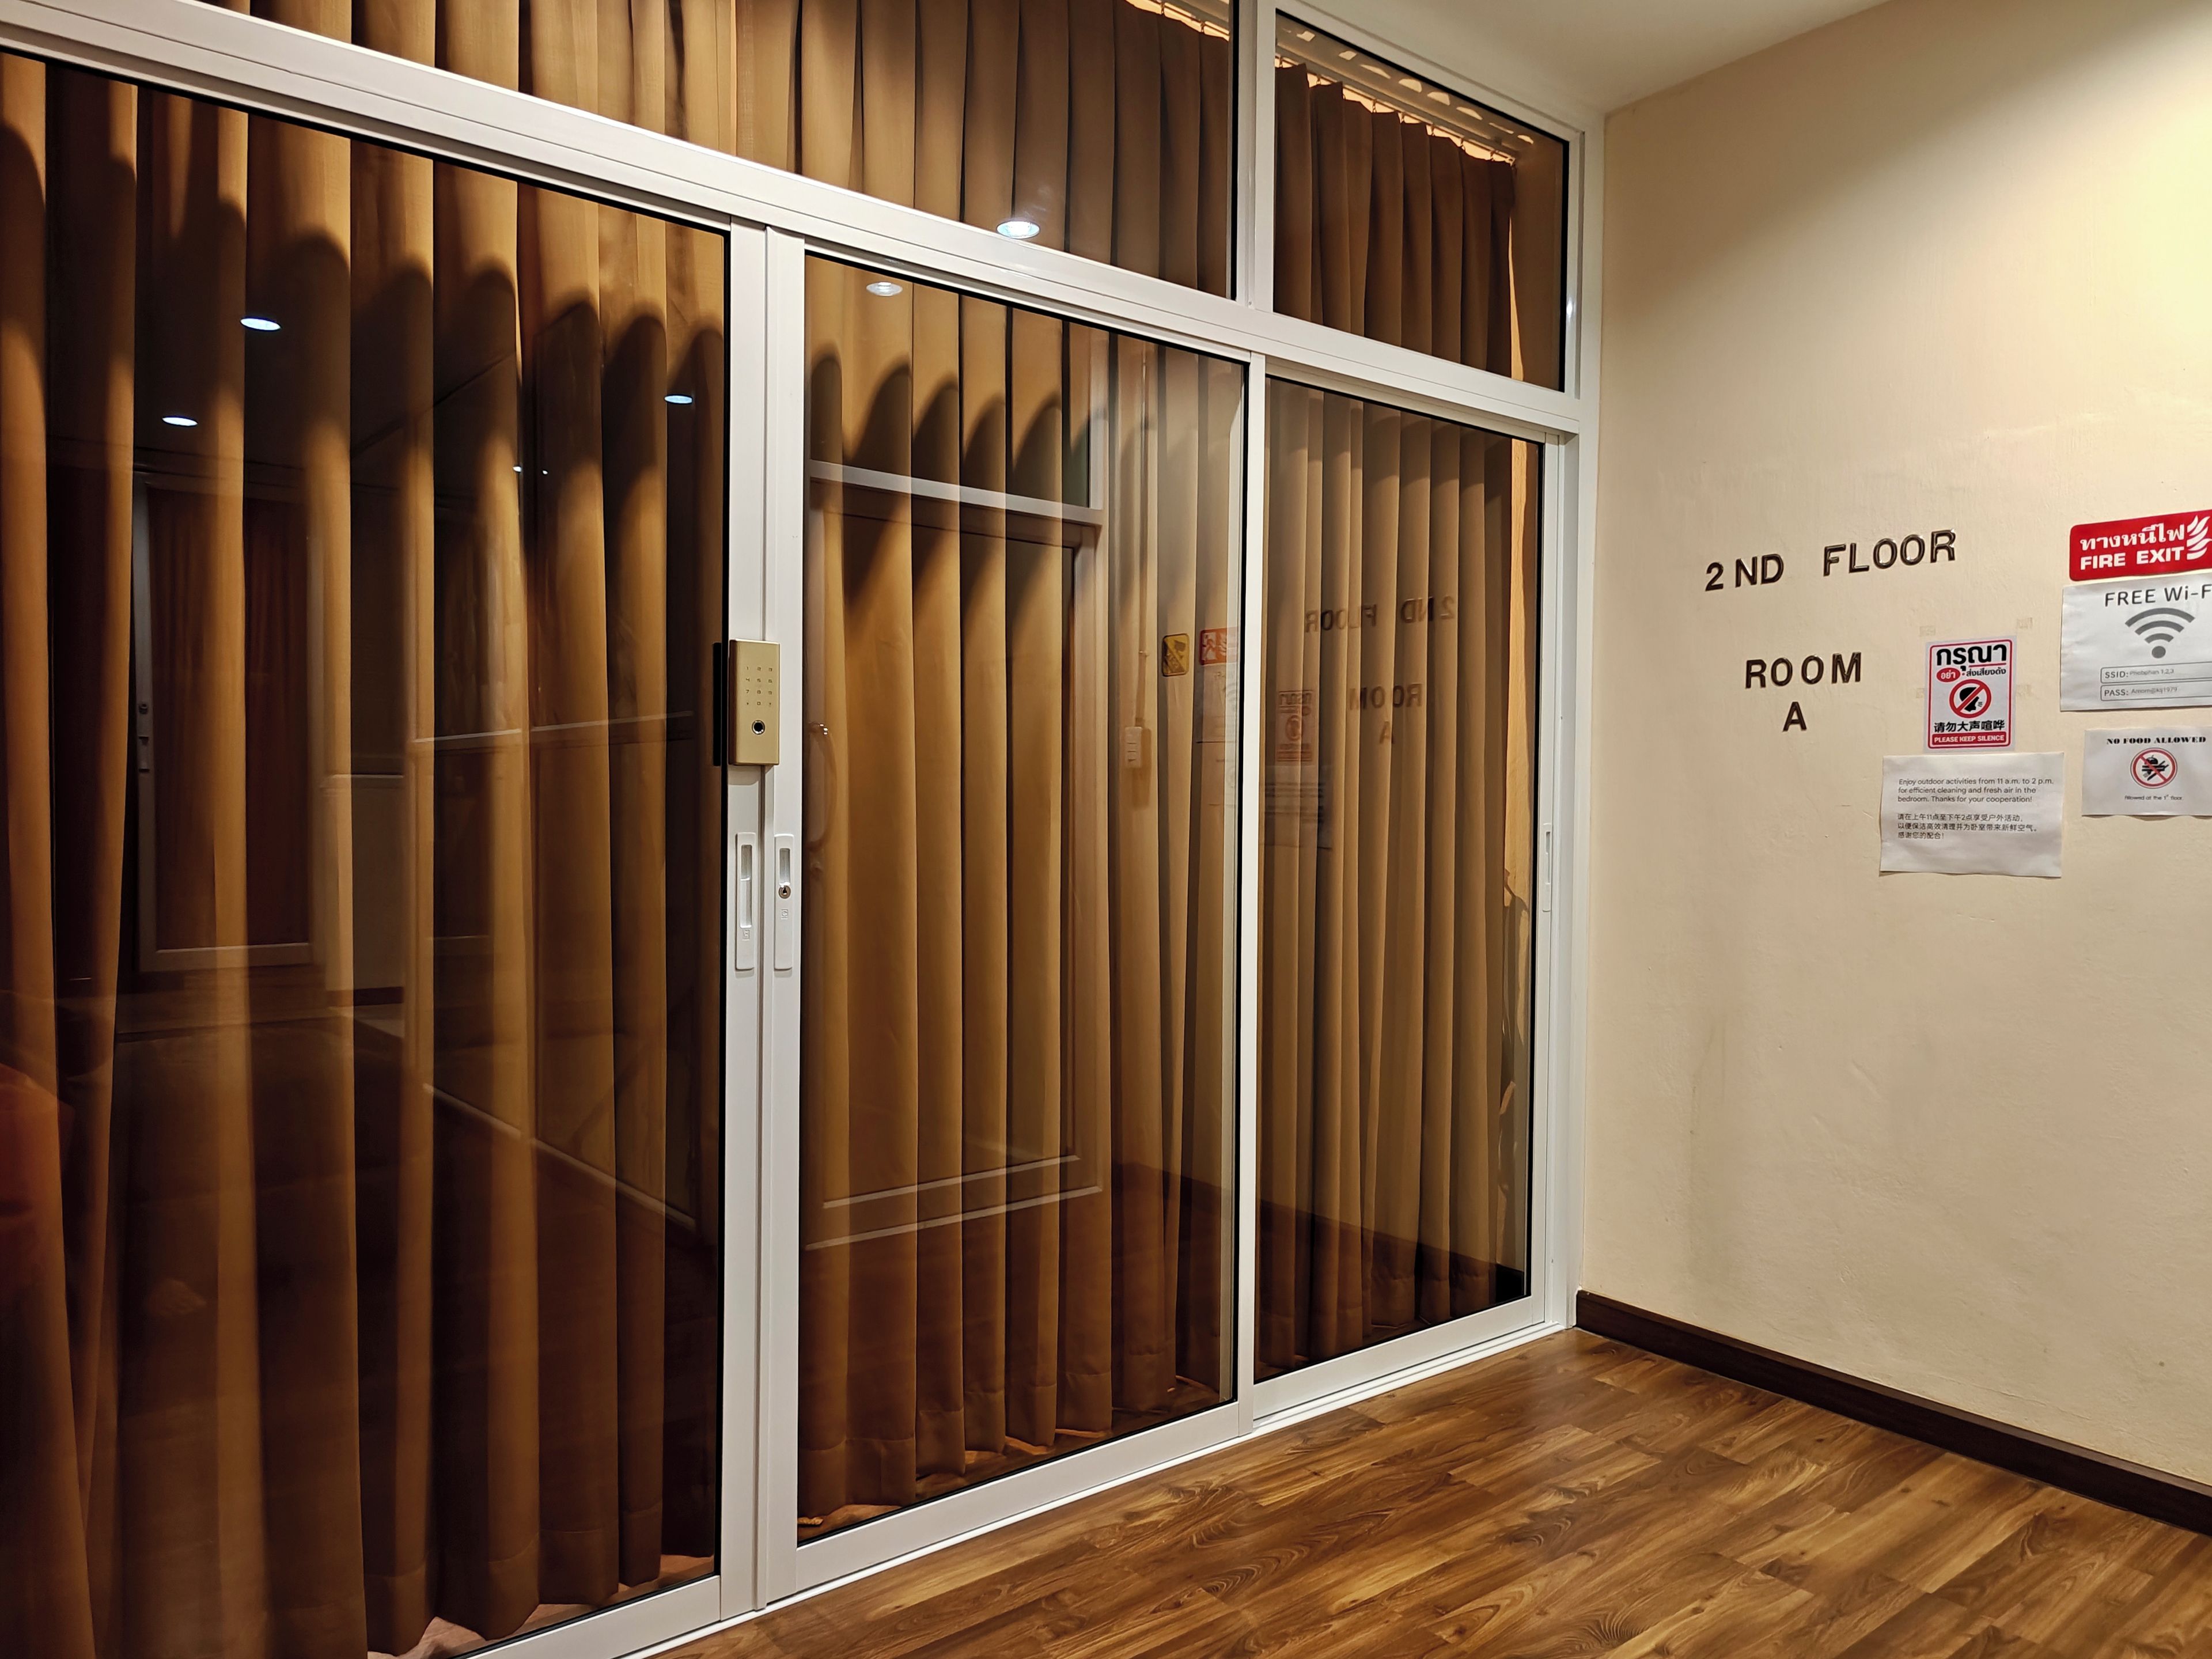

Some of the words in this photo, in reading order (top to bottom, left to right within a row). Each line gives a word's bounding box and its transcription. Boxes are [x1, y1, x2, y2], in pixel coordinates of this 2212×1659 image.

[2080, 523, 2184, 551] ทางหนีไฟ
[1705, 554, 1784, 592] 2ND
[1823, 529, 1956, 577] FLOOR
[2080, 552, 2126, 570] FIRE
[2137, 546, 2184, 565] EXIT
[2105, 589, 2156, 607] FREE
[1745, 652, 1861, 689] ROOM
[1936, 644, 2007, 671] กรุณา
[1941, 670, 1956, 679] อย่า
[1966, 667, 2006, 677] ส่งเสียงดัง
[1783, 702, 1807, 732] A
[1933, 720, 2005, 733] 请勿大声喧哗
